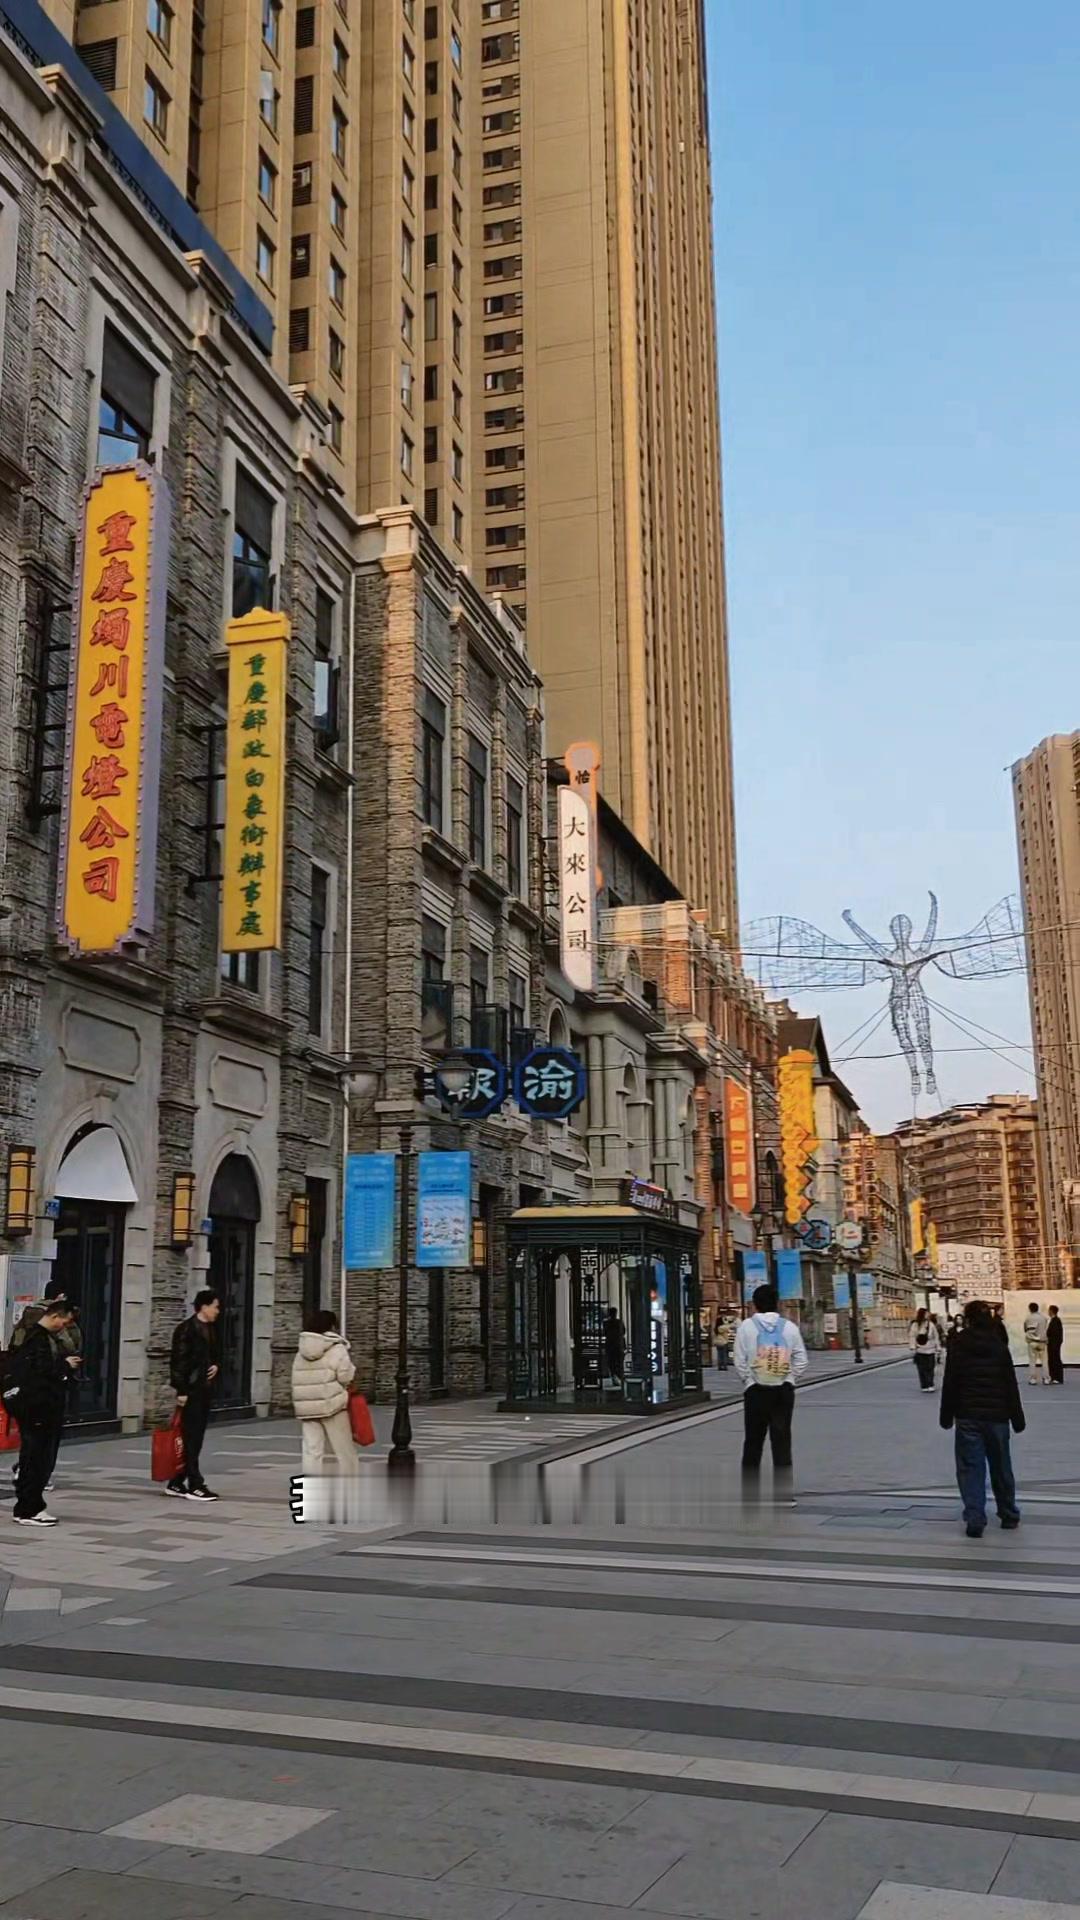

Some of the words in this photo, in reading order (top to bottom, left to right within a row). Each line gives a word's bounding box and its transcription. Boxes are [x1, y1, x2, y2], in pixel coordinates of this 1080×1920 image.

[563, 816, 587, 950] 大來公司
[523, 1059, 576, 1100] 渝
